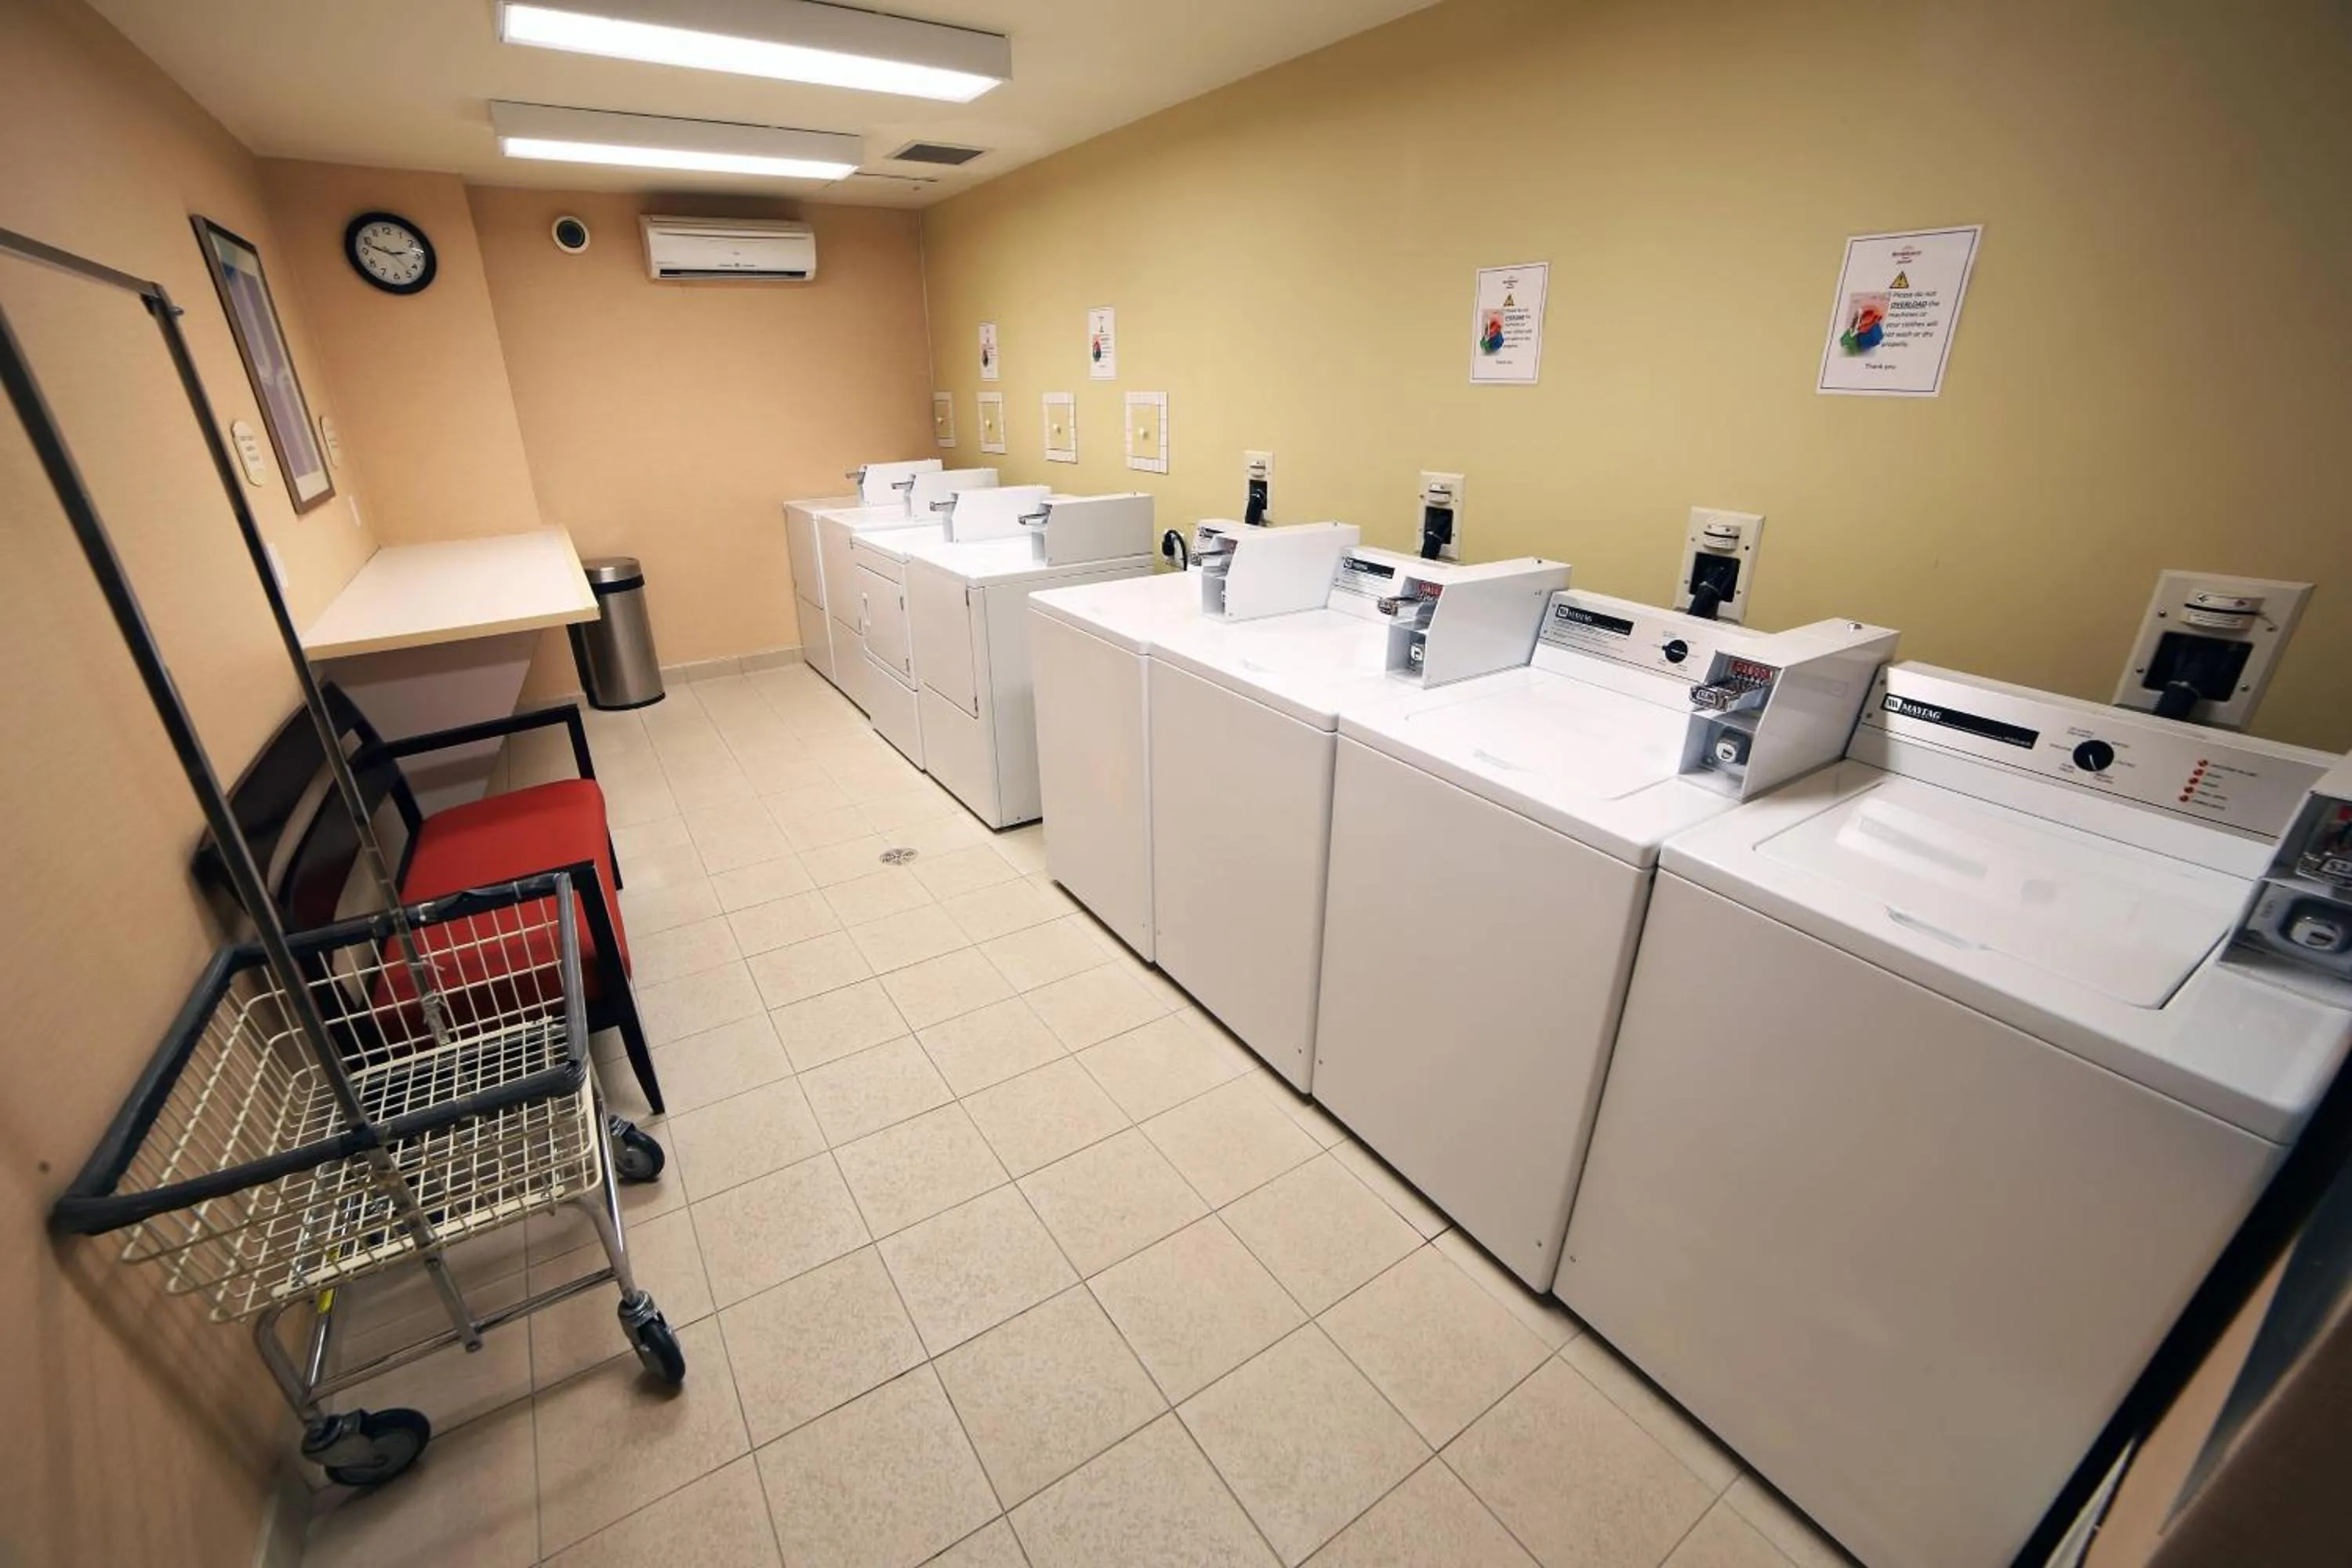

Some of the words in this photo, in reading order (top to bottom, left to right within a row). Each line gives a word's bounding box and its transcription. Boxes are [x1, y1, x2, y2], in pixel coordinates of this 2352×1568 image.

[382, 227, 391, 235] 12
[407, 239, 414, 248] 2
[380, 267, 387, 276] 7
[405, 270, 412, 278] 5
[1900, 702, 1942, 720] MAYTAG
